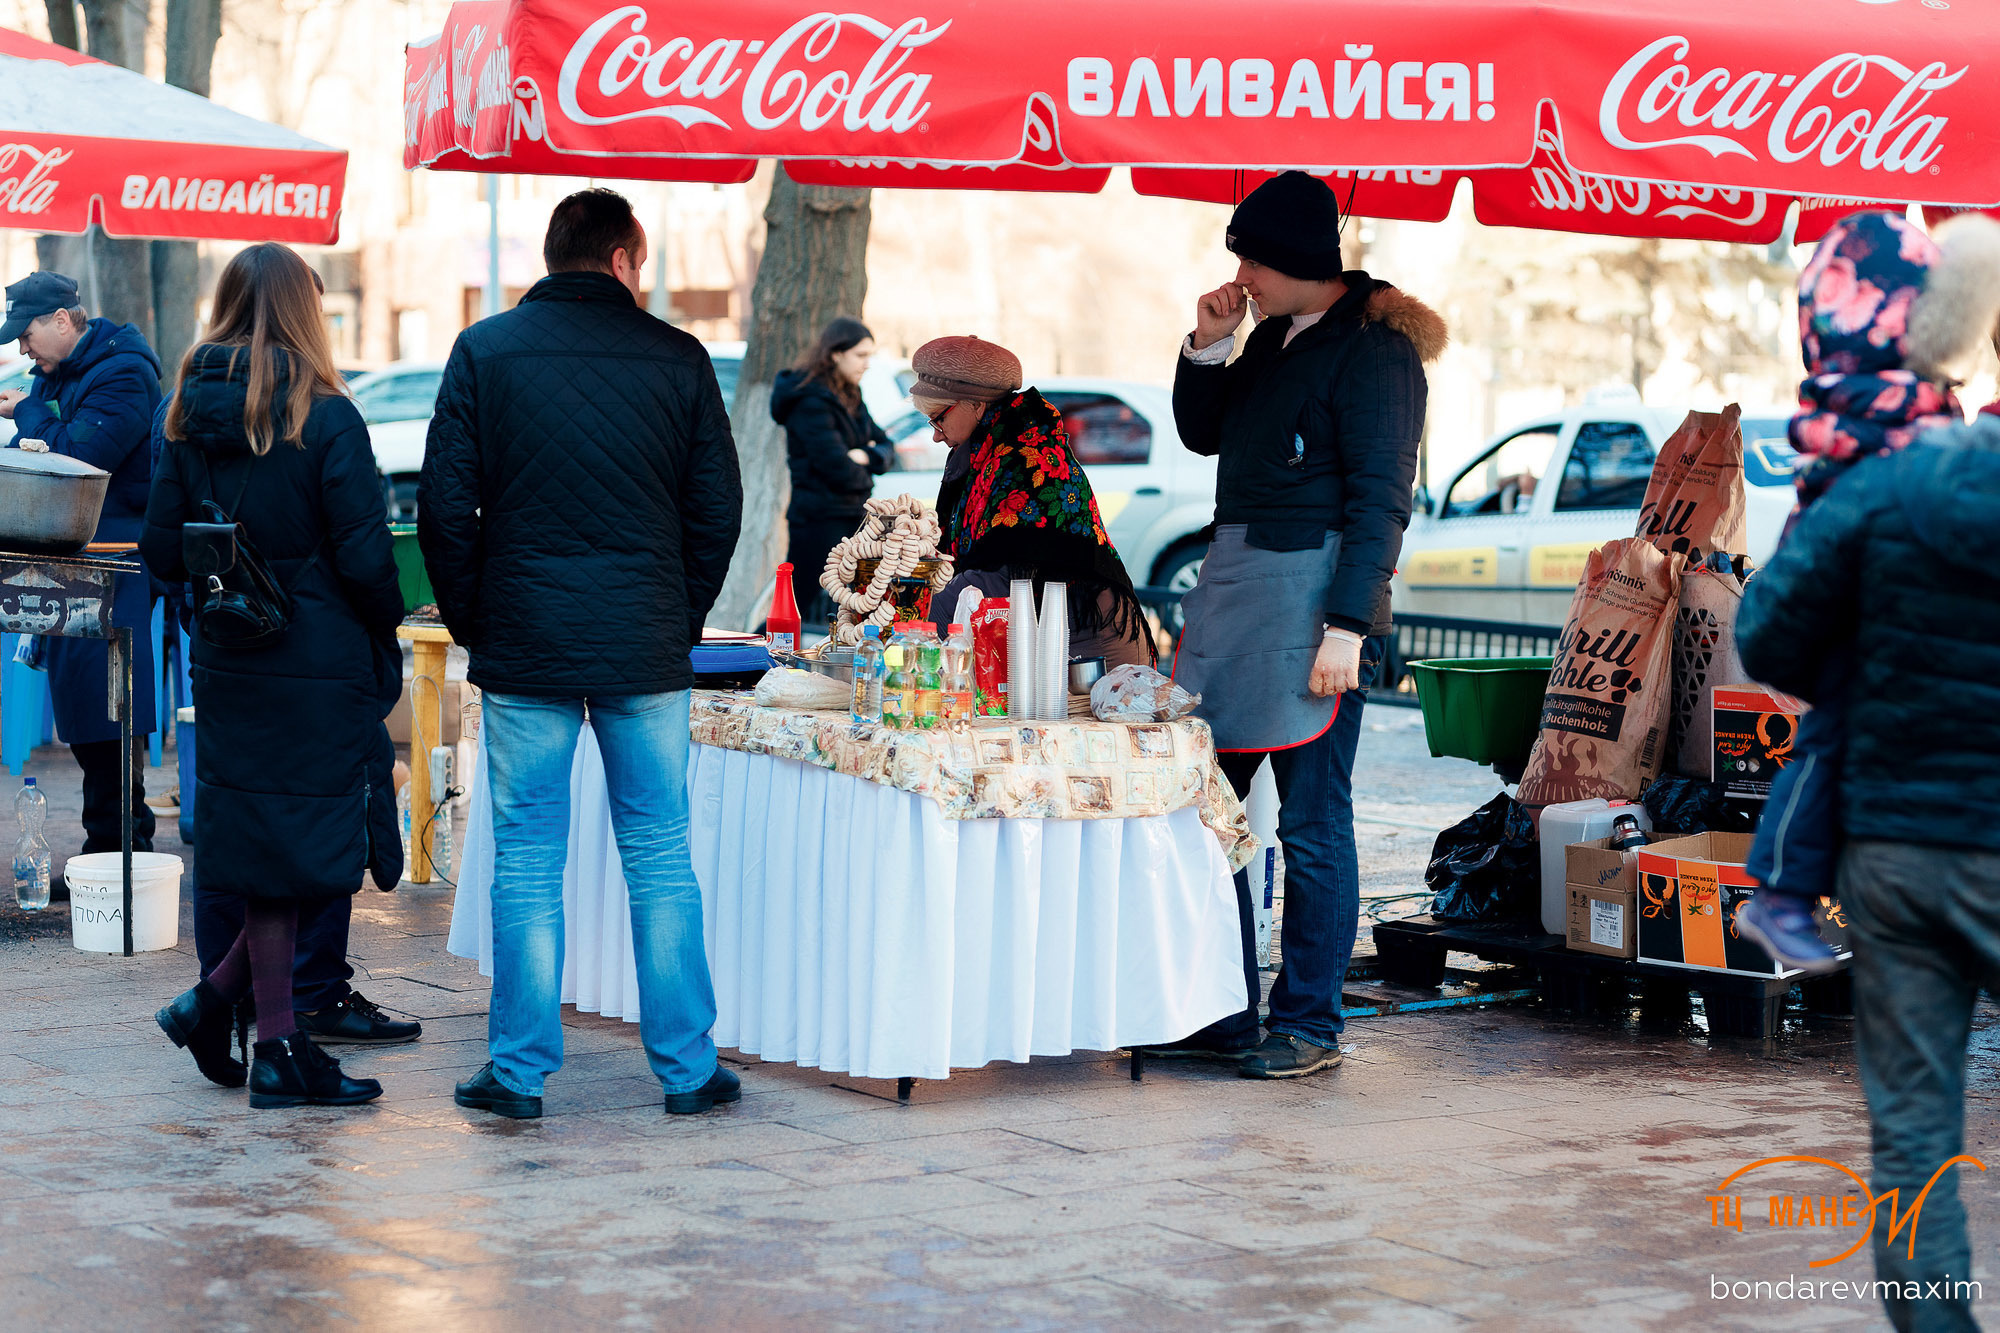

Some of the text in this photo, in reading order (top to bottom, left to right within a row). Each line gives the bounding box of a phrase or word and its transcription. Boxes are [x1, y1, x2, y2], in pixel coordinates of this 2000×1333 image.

[557, 5, 953, 134] Coca-Cola
[1066, 44, 1495, 122] ВЛИВАЙСЯ!
[1600, 35, 1968, 174] Coca-Cola
[120, 174, 330, 219] ВЛИВАЙСЯ!
[1550, 657, 1609, 693] ohle
[1546, 712, 1608, 733] Buchenholz
